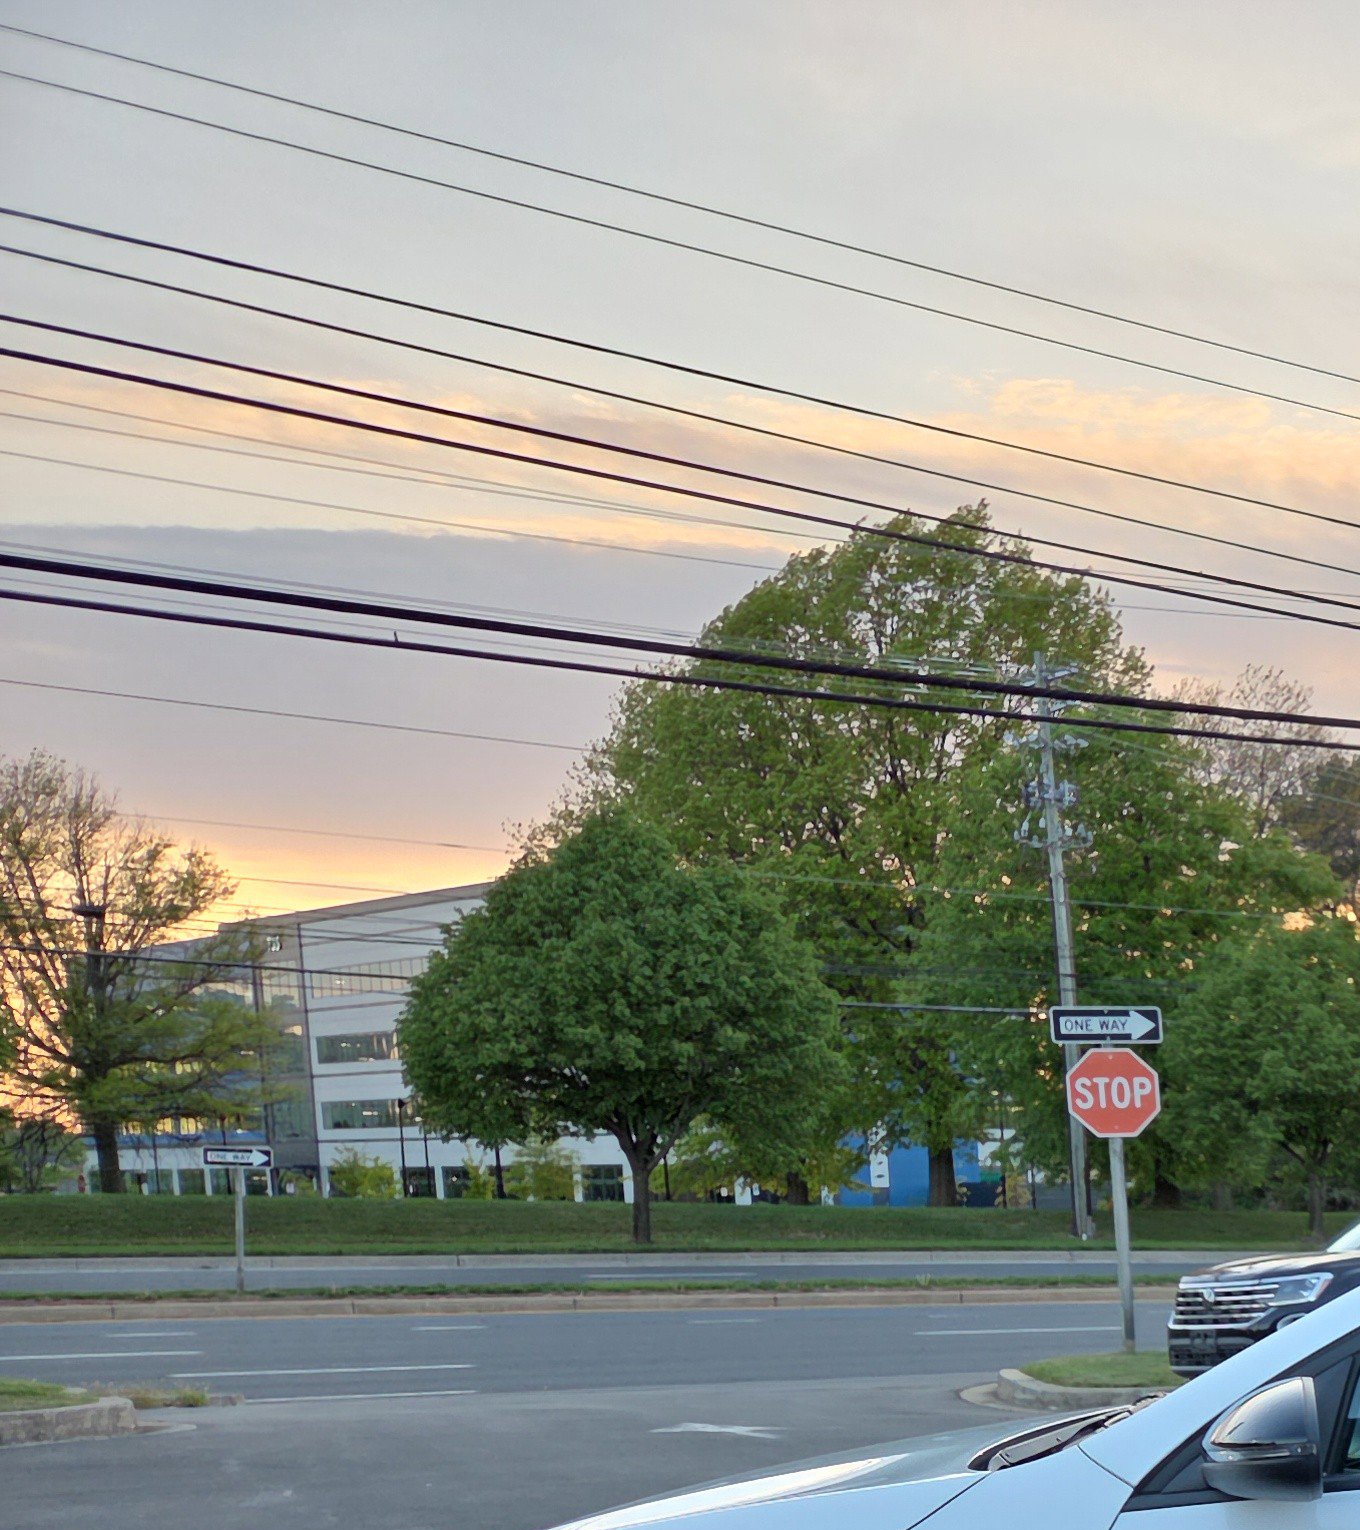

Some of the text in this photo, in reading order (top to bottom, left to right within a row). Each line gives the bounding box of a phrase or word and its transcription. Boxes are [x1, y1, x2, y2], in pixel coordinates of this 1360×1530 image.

[1064, 1018, 1128, 1032] ONE WAY
[1074, 1076, 1152, 1110] STOP
